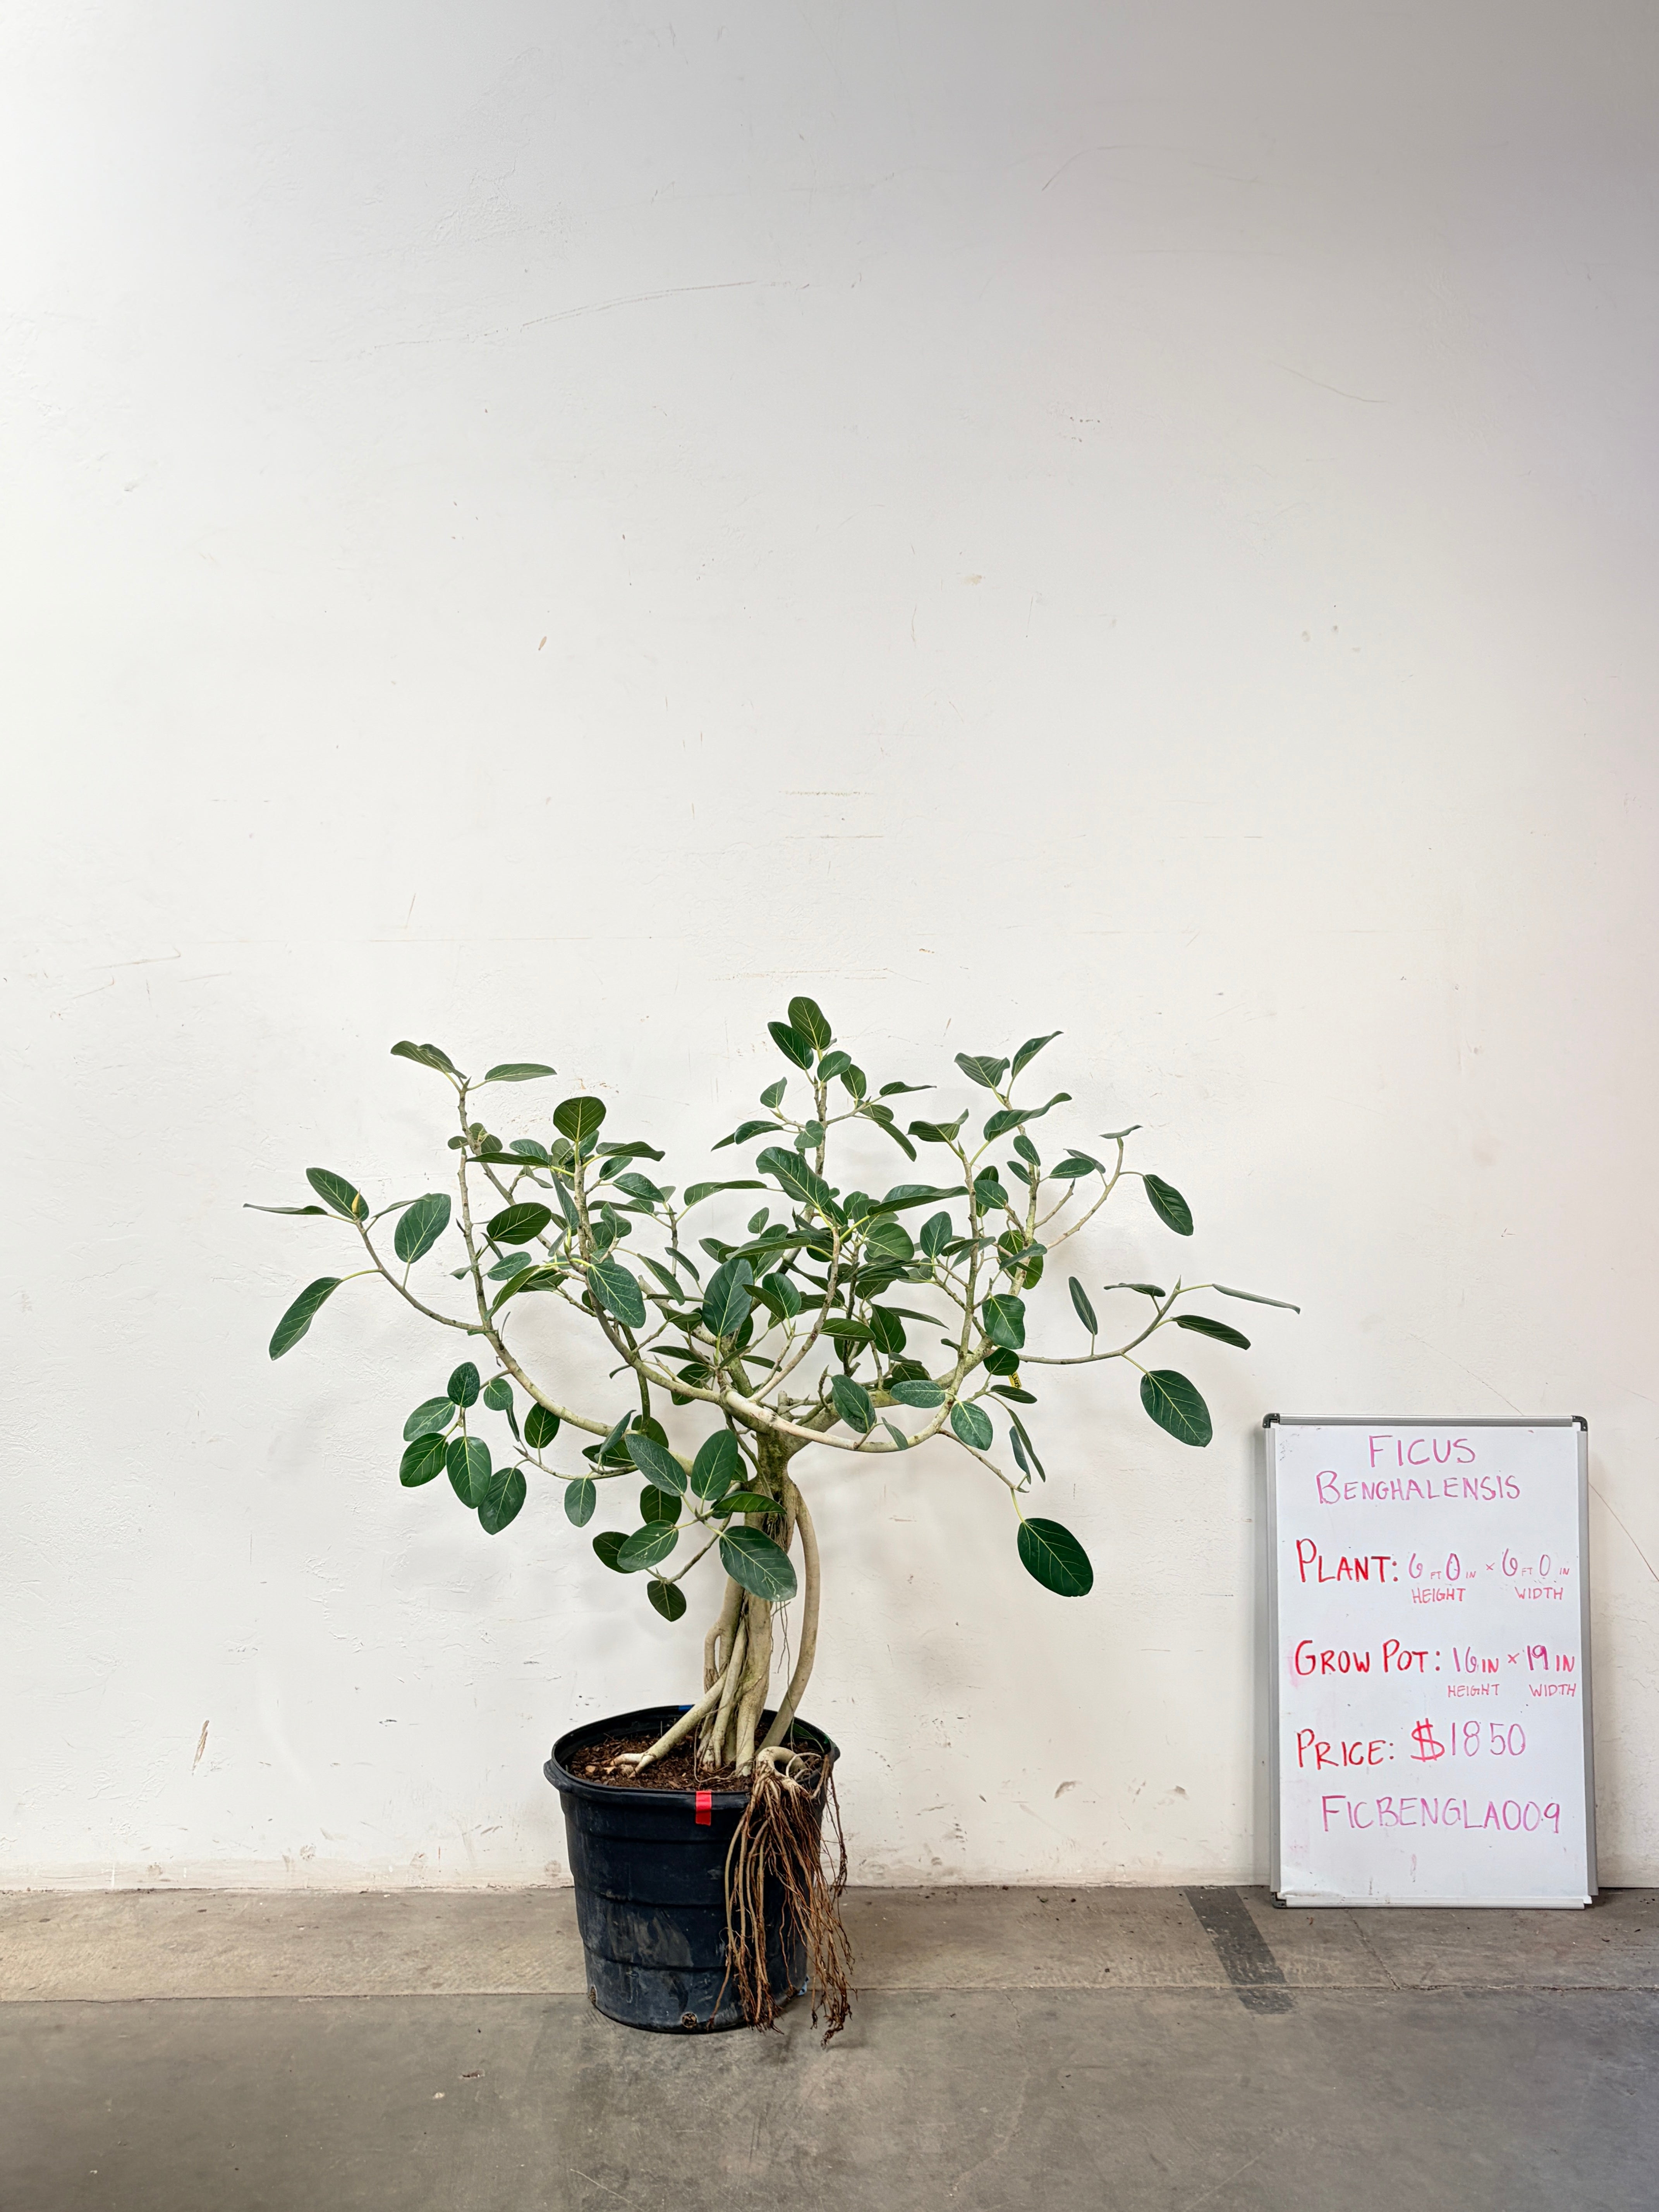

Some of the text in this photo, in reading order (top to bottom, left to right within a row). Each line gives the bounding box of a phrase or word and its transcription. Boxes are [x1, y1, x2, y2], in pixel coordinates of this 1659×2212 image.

[1369, 1436, 1475, 1467] FICUS
[1316, 1471, 1520, 1504] BENGHALENSIS
[1296, 1539, 1398, 1583] PLANT:
[1412, 1587, 1563, 1604] HEIGHT WIDTH
[1295, 1640, 1370, 1676] GROW
[1382, 1639, 1440, 1673] POT:
[1448, 1683, 1576, 1697] HEIGHT WIDTH
[1297, 1718, 1525, 1770] PRICE: $1850
[1322, 1795, 1559, 1833] FICBENGLA009
